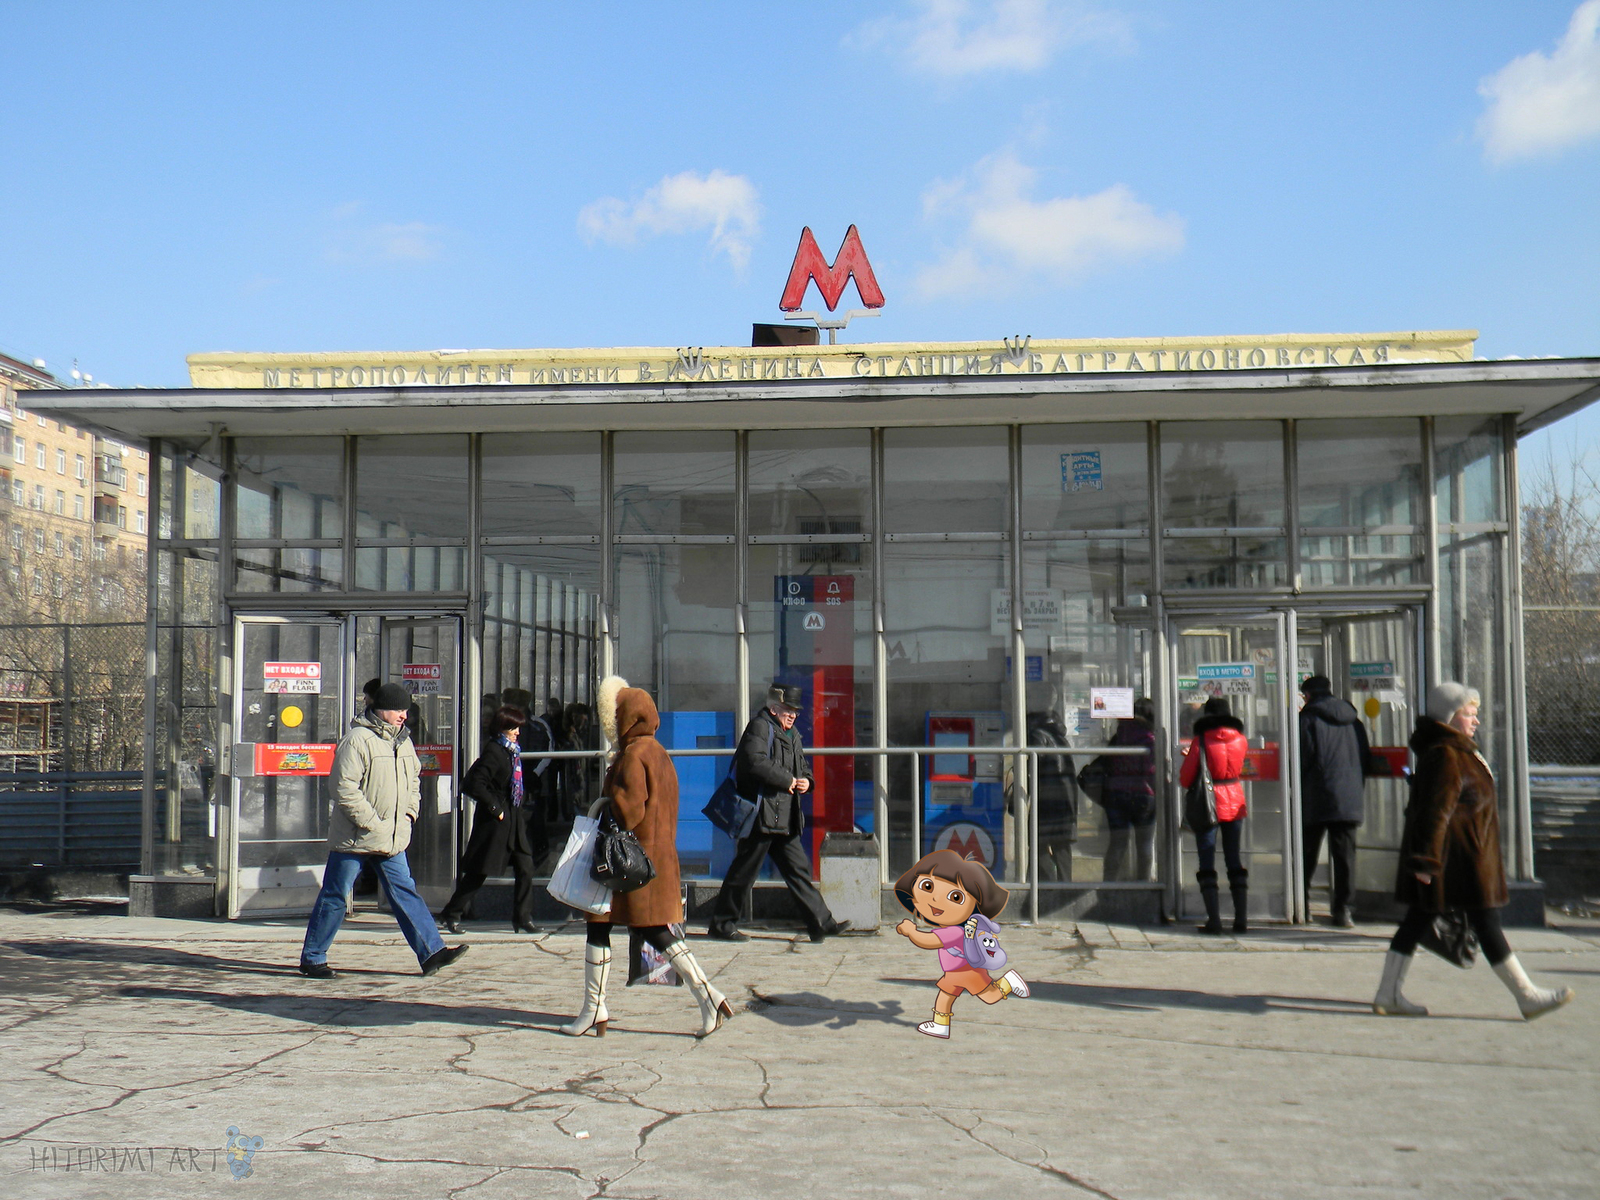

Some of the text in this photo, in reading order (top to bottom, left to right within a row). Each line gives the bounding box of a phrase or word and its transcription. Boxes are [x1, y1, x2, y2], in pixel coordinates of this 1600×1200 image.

[779, 223, 886, 312] М
[263, 363, 514, 388] МЕТРОПОЛИТЕН
[530, 366, 620, 383] ИМЕНИ
[852, 352, 1004, 377] СТАНЦИЯ
[1028, 344, 1390, 373] БАГРАТИОНОВСКАЯ
[783, 597, 806, 606] ИНФО
[826, 597, 841, 606] SOS
[807, 615, 822, 627] М
[266, 666, 305, 674] НЕТ ВХОДА
[403, 667, 431, 675] НЕТ ВХОДА
[1199, 668, 1215, 676] ВХОД
[1221, 667, 1241, 675] МЕТРО
